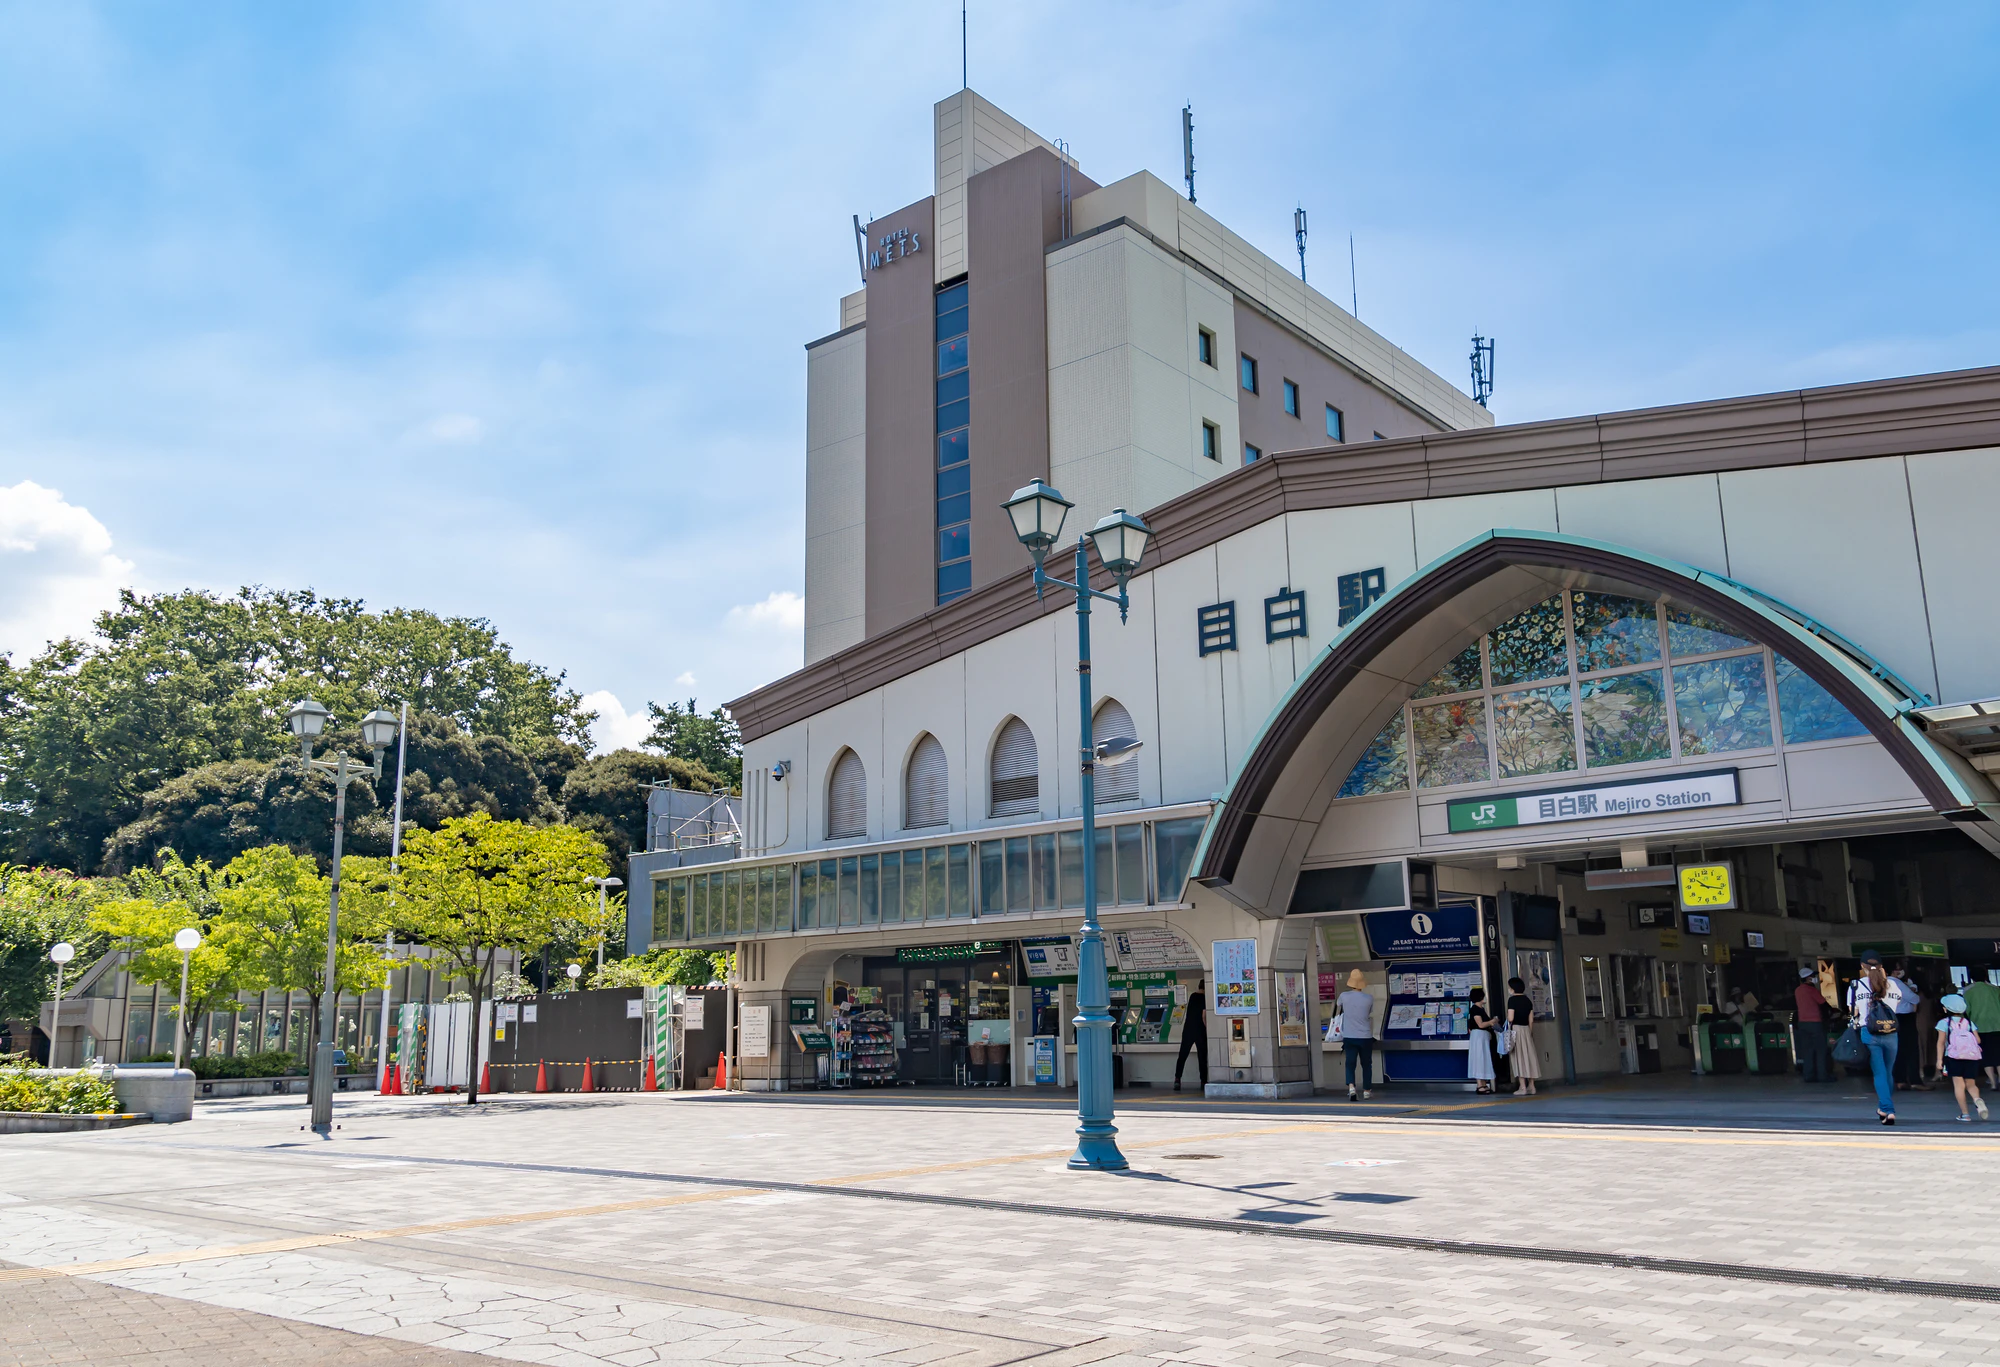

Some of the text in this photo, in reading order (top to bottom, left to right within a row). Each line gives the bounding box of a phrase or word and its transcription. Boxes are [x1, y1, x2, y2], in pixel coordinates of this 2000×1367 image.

[880, 227, 909, 247] HOTEL
[870, 233, 920, 270] METS
[1198, 567, 1386, 658] 目白駅
[1471, 804, 1497, 820] JR
[1538, 789, 1712, 819] 目白駅 Mejiro Station
[1431, 936, 1461, 944] Information
